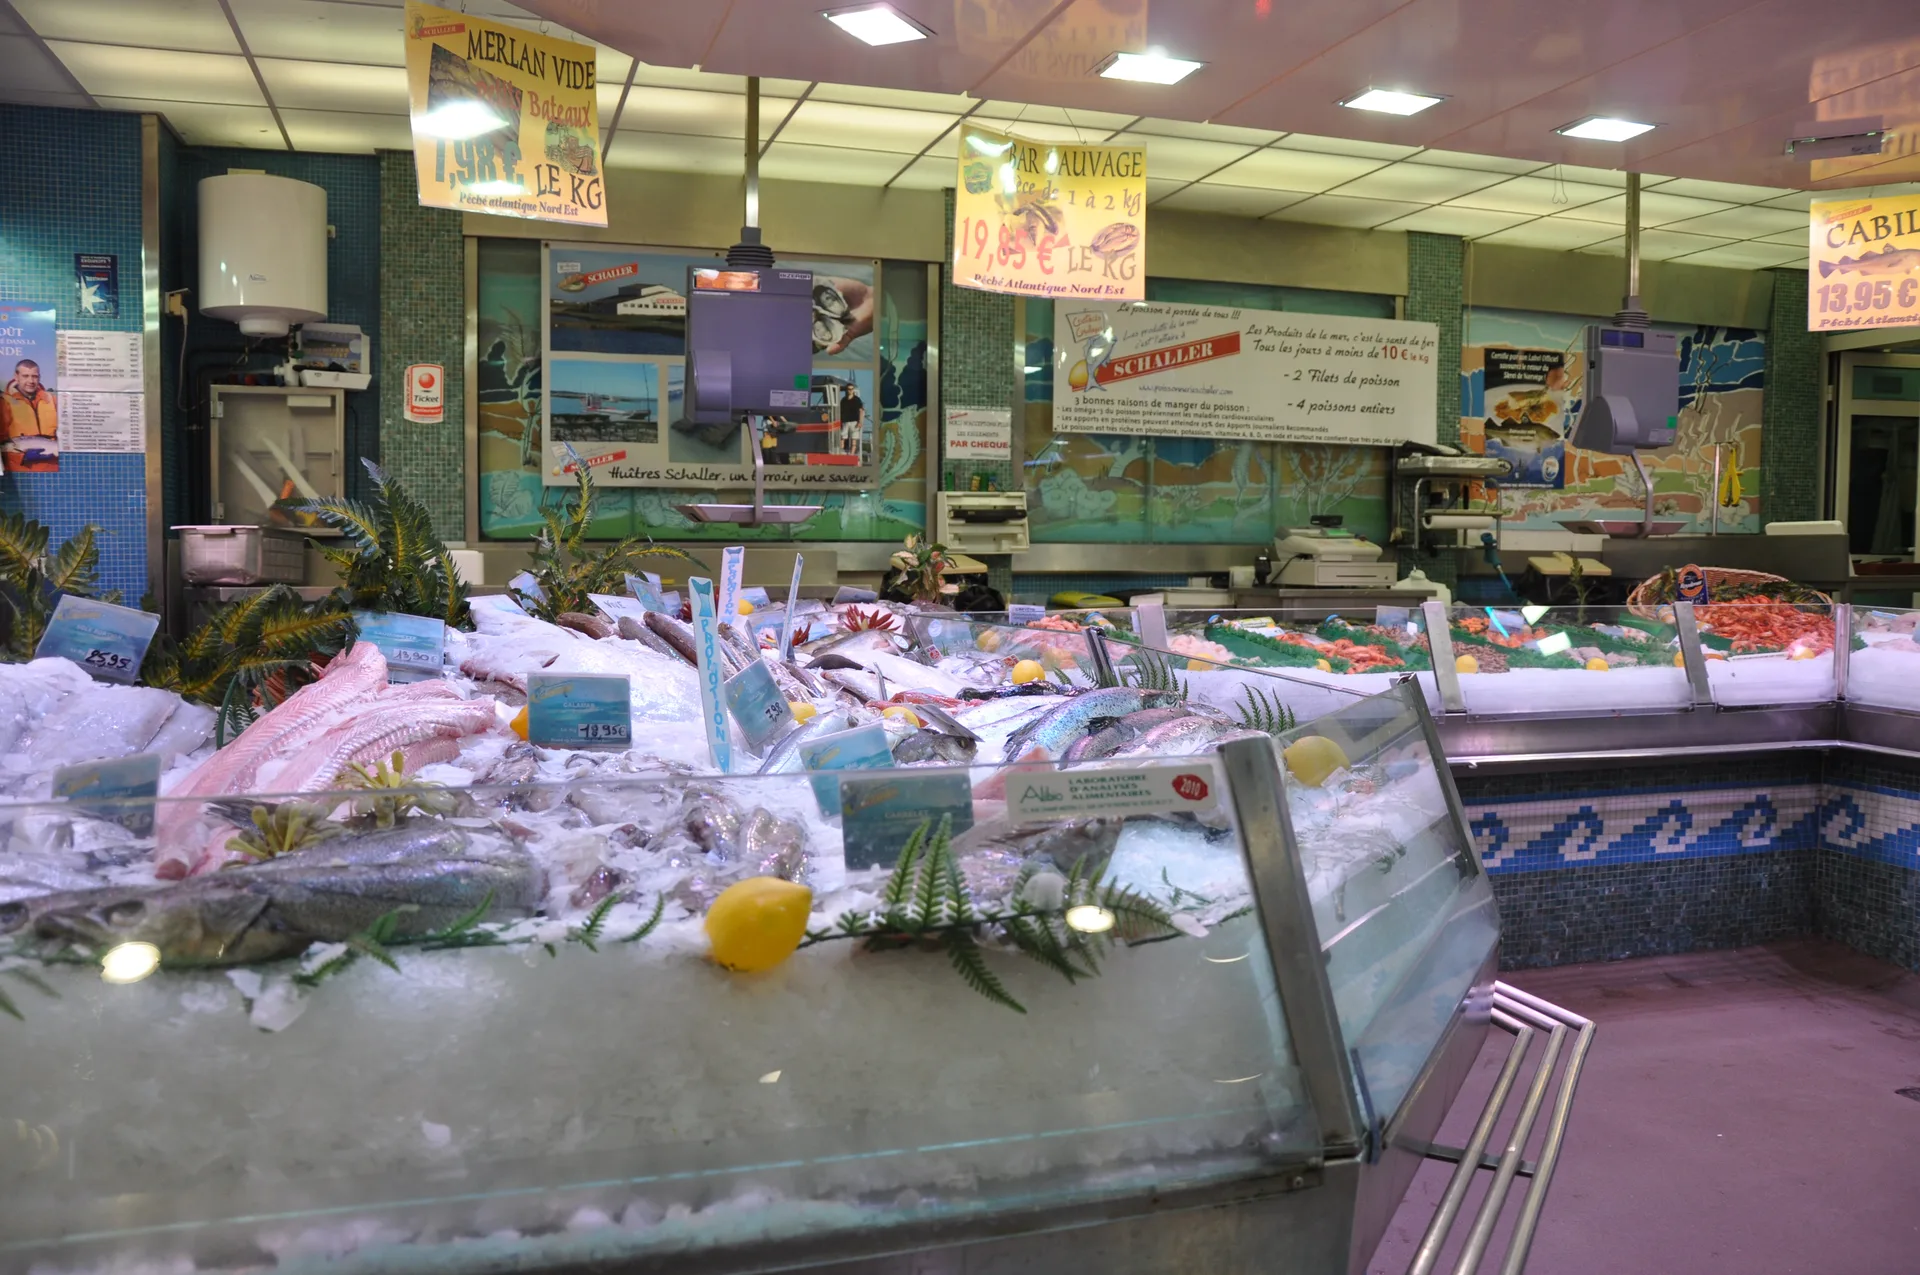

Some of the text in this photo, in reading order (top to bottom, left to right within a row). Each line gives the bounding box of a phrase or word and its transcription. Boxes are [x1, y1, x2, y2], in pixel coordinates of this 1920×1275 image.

[467, 29, 595, 90] MERLAN VIDE
[528, 91, 592, 128] Bateaux
[1009, 143, 1040, 174] BAR
[535, 164, 602, 210] LE KG
[1041, 180, 1142, 217] de 1 à 2 kg
[539, 202, 563, 216] Nord
[564, 204, 578, 216] Est
[962, 216, 1055, 275] 19,85 €
[1067, 245, 1137, 281] LE KG
[588, 266, 633, 283] SCHALLER
[1004, 278, 1125, 295] Atlantique Nord Est
[1817, 278, 1918, 314] 13,95 €
[1117, 303, 1128, 312] Le
[1130, 304, 1163, 316] poisson
[1166, 305, 1172, 314] à
[1172, 306, 1199, 318] portée
[1202, 306, 1212, 317] de
[1214, 310, 1229, 319] tous
[1123, 330, 1139, 341] Les
[1169, 320, 1179, 331] de
[1179, 319, 1186, 328] la
[1246, 324, 1262, 335] Les
[1265, 325, 1303, 338] Produits
[1306, 328, 1317, 339] de
[1319, 329, 1327, 339] la
[1353, 332, 1373, 342] c'est
[1375, 334, 1383, 343] la
[1386, 336, 1407, 345] santé
[1409, 336, 1419, 346] de
[1421, 336, 1435, 352] fer
[1253, 339, 1275, 352] Tous
[1279, 341, 1293, 354] les
[1294, 343, 1322, 359] jours
[1325, 346, 1331, 356] à
[1335, 347, 1364, 358] moins
[1367, 348, 1379, 359] de
[1381, 346, 1397, 360] 10
[1400, 349, 1408, 361] €
[1114, 342, 1213, 377] SCHALLER
[1292, 368, 1400, 388] 2 Filets de poisson
[414, 394, 439, 403] Ticket
[1075, 396, 1245, 413] 3 bonnes raisons de manger du poisson
[1296, 399, 1395, 415] 4 poissons entiers
[1074, 416, 1100, 424] apports
[1143, 419, 1169, 427] peuvent
[1171, 419, 1200, 427] atteindre
[1227, 423, 1250, 431] Apports
[1116, 408, 1141, 417] poisson
[1183, 410, 1191, 418] les
[1193, 411, 1220, 419] maladies
[1222, 414, 1274, 422] cardiovasculaires
[1070, 424, 1094, 433] poisson
[950, 440, 968, 448] PAR
[608, 466, 661, 481] Huîtres
[729, 471, 748, 482] un
[751, 469, 798, 485] trroir,
[801, 472, 825, 483] une
[829, 472, 874, 484] saveur.
[1069, 774, 1147, 785] LABORATOIRE
[1179, 779, 1201, 796] 2010
[1071, 790, 1152, 801] ALIMENTAIRES
